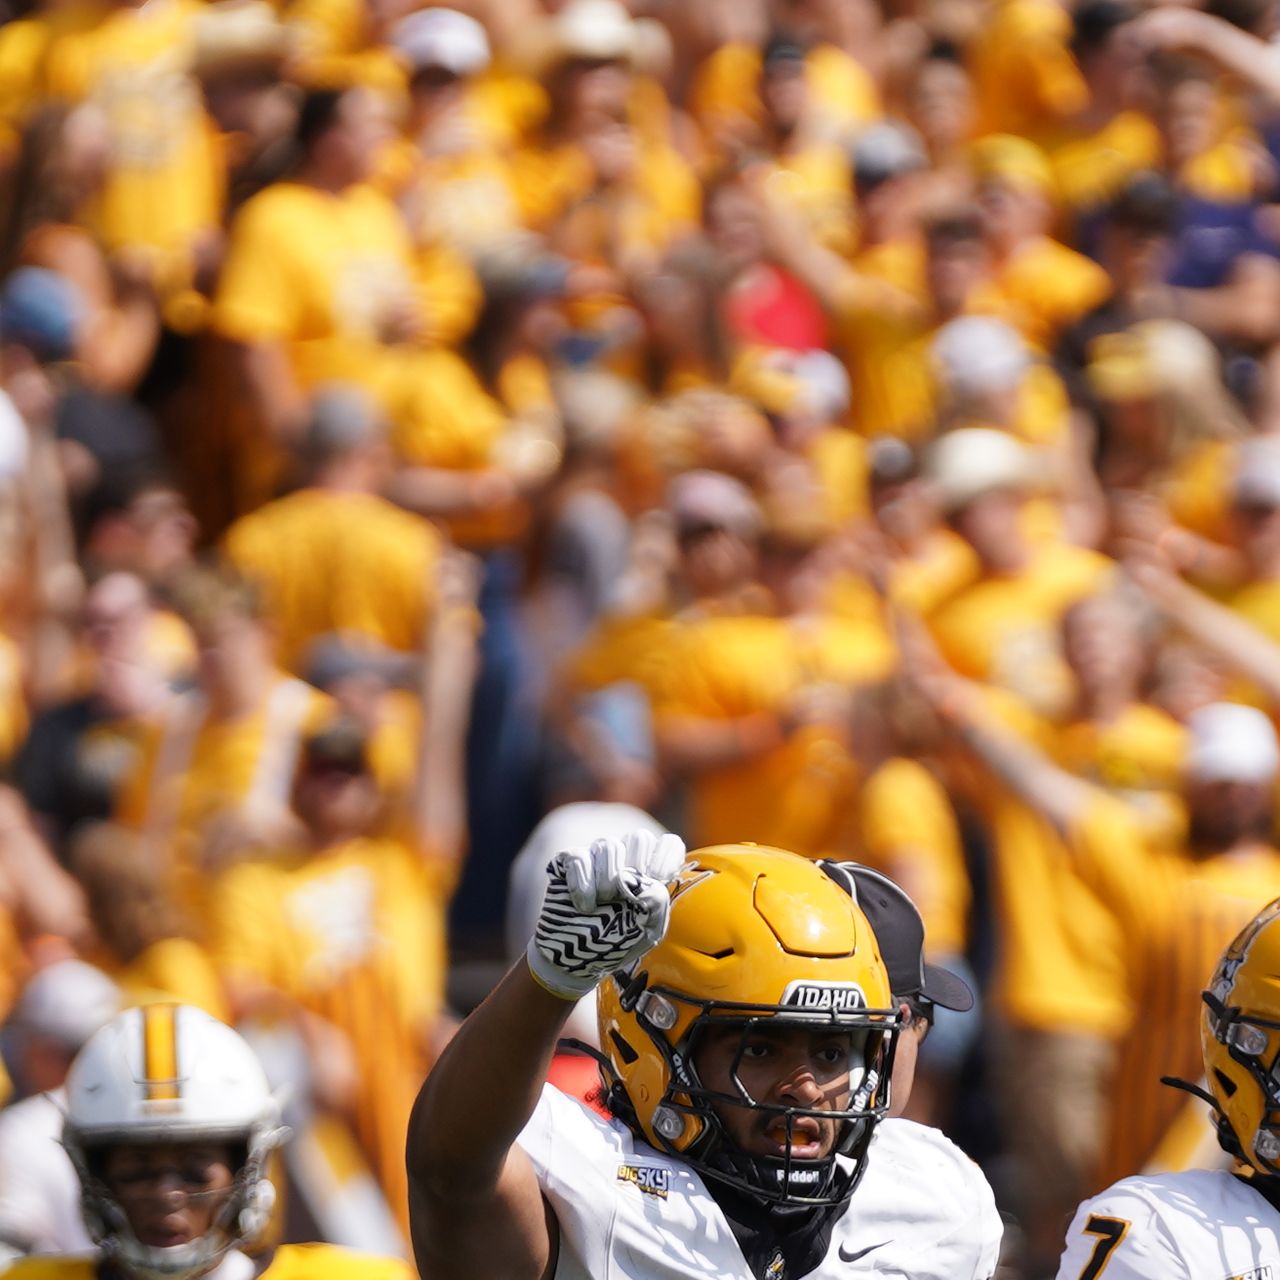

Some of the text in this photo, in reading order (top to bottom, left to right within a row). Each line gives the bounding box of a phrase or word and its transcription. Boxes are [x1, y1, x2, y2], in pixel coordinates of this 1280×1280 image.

[797, 986, 860, 1009] IDAHO
[617, 1165, 638, 1183] BIG
[637, 1167, 668, 1191] SKY
